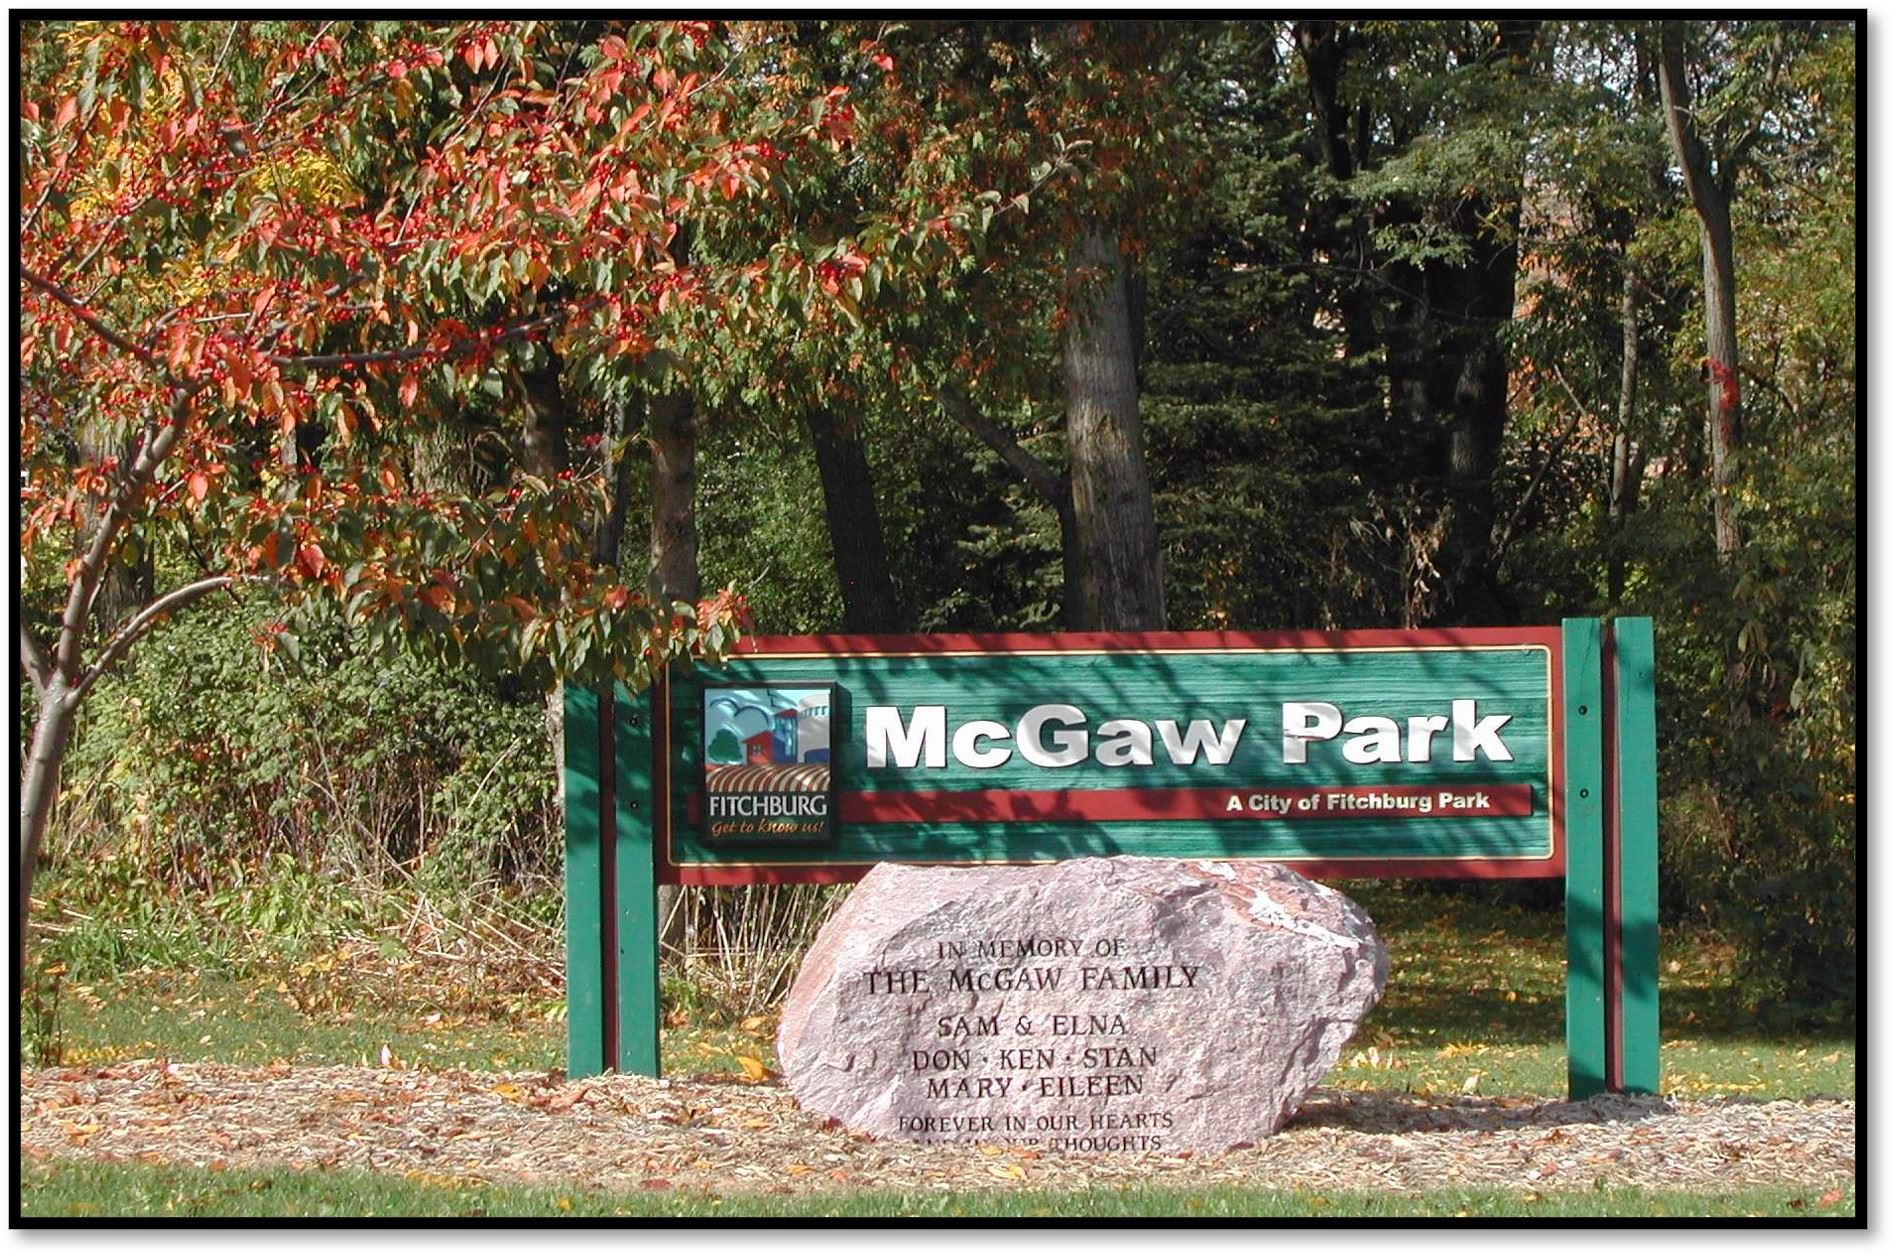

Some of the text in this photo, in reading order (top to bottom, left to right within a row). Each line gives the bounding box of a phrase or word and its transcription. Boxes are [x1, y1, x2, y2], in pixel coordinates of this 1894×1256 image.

[866, 699, 1514, 768] McGaw Park
[709, 794, 827, 816] FITCHBURG
[1226, 791, 1490, 815] A City of Fitchburg Park
[740, 820, 754, 833] to
[758, 818, 797, 833] know
[801, 820, 824, 833] us!
[938, 937, 1126, 960] IN MEMORY OF
[863, 970, 929, 995] THE
[1082, 965, 1201, 991] FAMILY
[938, 1014, 1128, 1038] SAM & ELNA
[913, 1049, 970, 1071] DON
[1000, 1048, 1055, 1070] KEN
[1083, 1046, 1157, 1069] STAN
[927, 1078, 1013, 1099] MARY
[1041, 1075, 1143, 1098] EILEEN
[900, 1112, 1173, 1133] FOREVER IN OUR HEARTS
[1054, 1135, 1162, 1151] THOUGHTS
